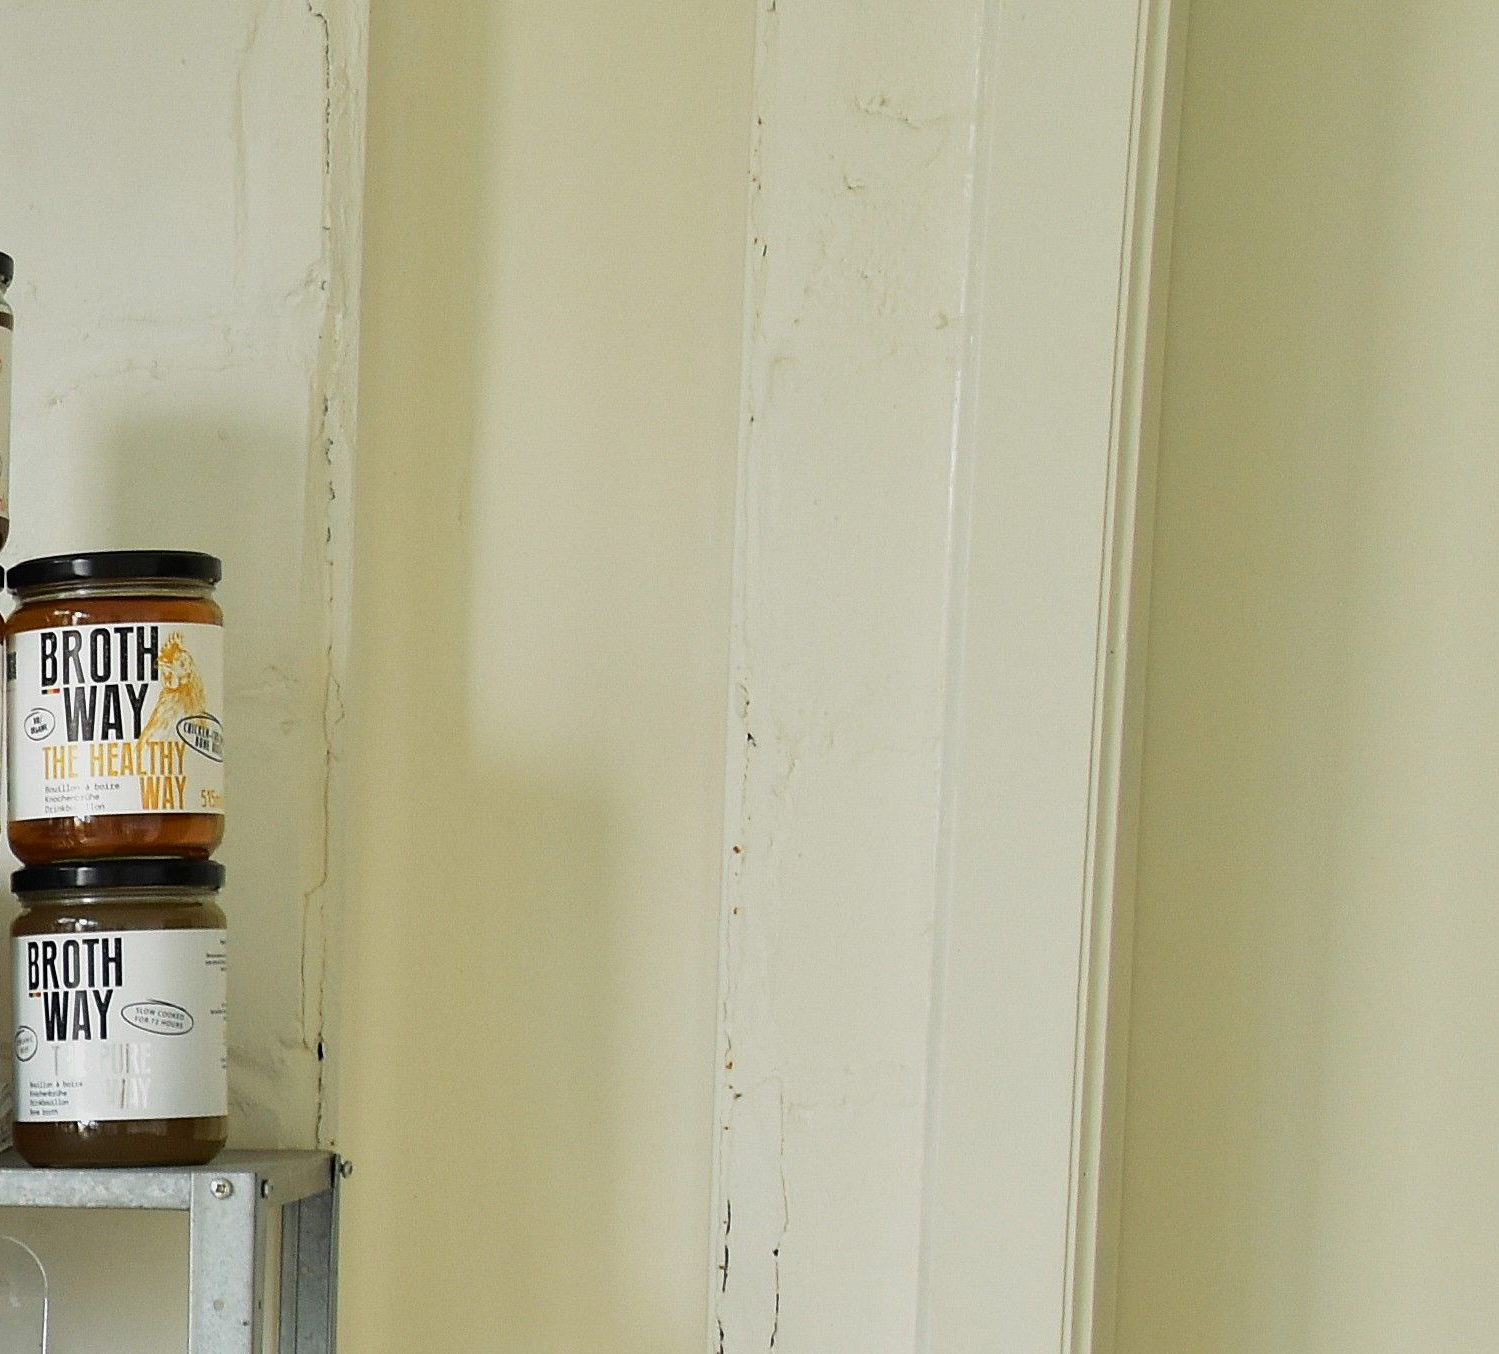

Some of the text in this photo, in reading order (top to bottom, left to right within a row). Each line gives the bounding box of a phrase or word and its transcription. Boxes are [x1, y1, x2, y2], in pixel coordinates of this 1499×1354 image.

[40, 626, 159, 687] BROTH
[63, 683, 149, 742] WAY
[42, 746, 78, 780] THE
[89, 741, 187, 777] HEALTHY
[139, 776, 187, 810] WAY
[27, 937, 122, 990] BROTH
[43, 989, 113, 1042] WAY
